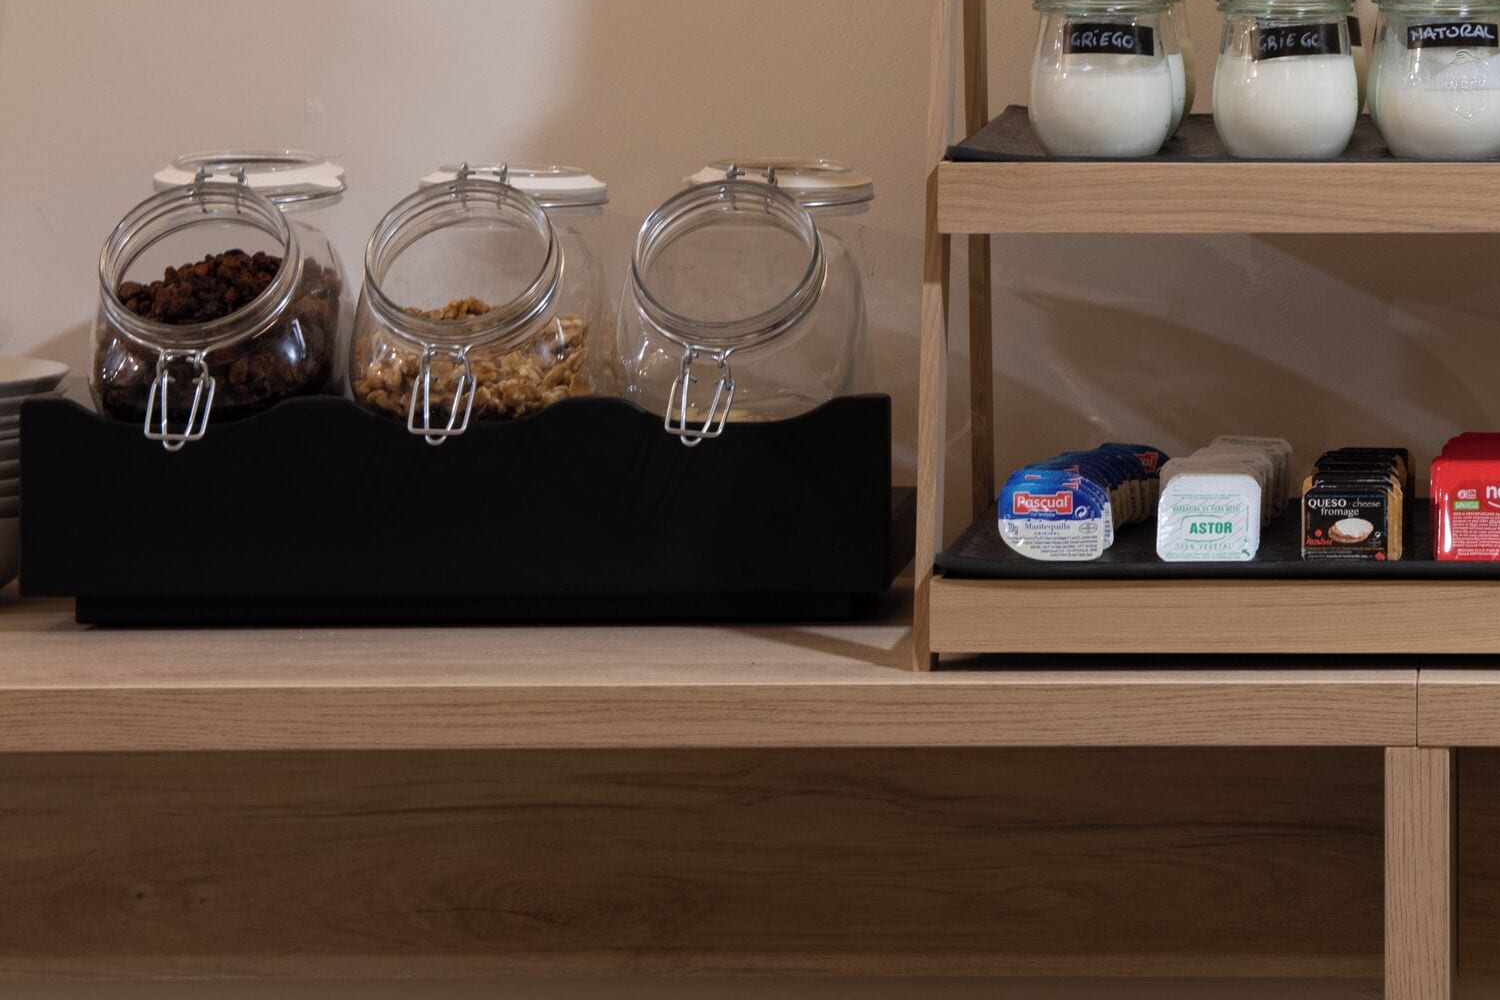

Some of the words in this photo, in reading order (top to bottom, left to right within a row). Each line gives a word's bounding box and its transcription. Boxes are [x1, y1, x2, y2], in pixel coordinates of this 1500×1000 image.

[1410, 23, 1495, 41] NATURAL
[1017, 496, 1068, 508] Pascual
[1308, 498, 1347, 509] QUESO
[1352, 498, 1381, 508] cheese
[1320, 507, 1360, 518] fromage
[1189, 522, 1233, 535] ASTOR
